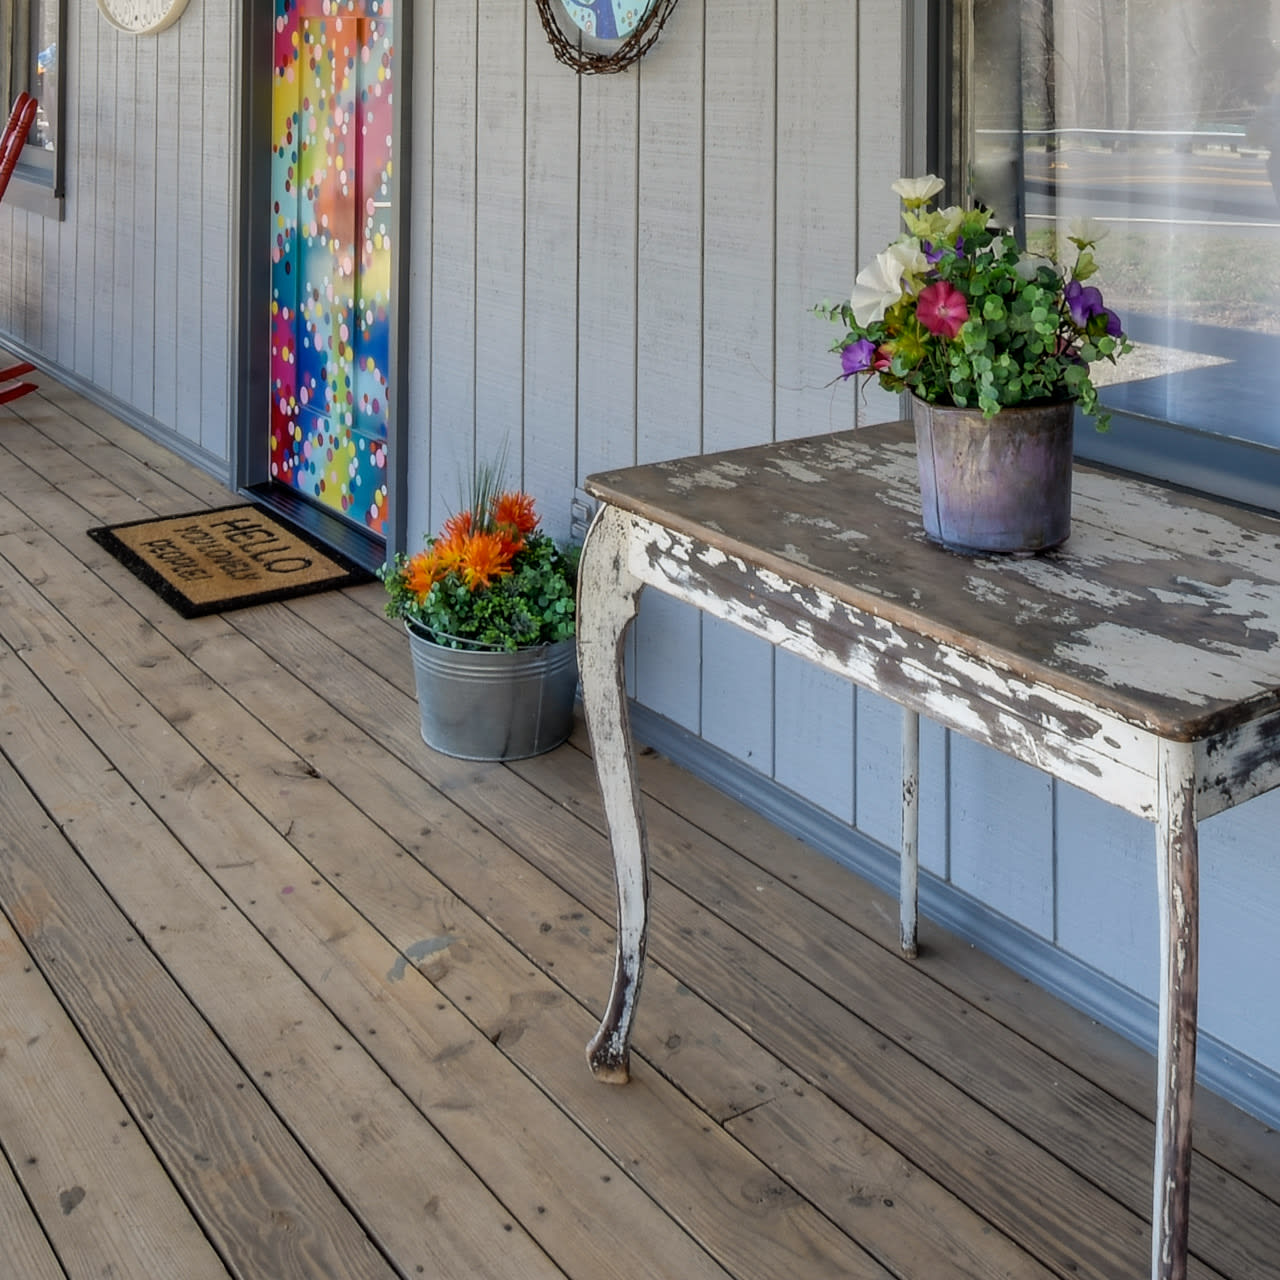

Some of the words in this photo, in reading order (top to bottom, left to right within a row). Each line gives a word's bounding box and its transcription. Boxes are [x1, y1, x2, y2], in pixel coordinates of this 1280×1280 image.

[139, 538, 214, 582] PEOPLE!
[172, 525, 217, 546] YOU
[197, 543, 263, 581] LOVELY
[209, 518, 313, 573] HELLO
